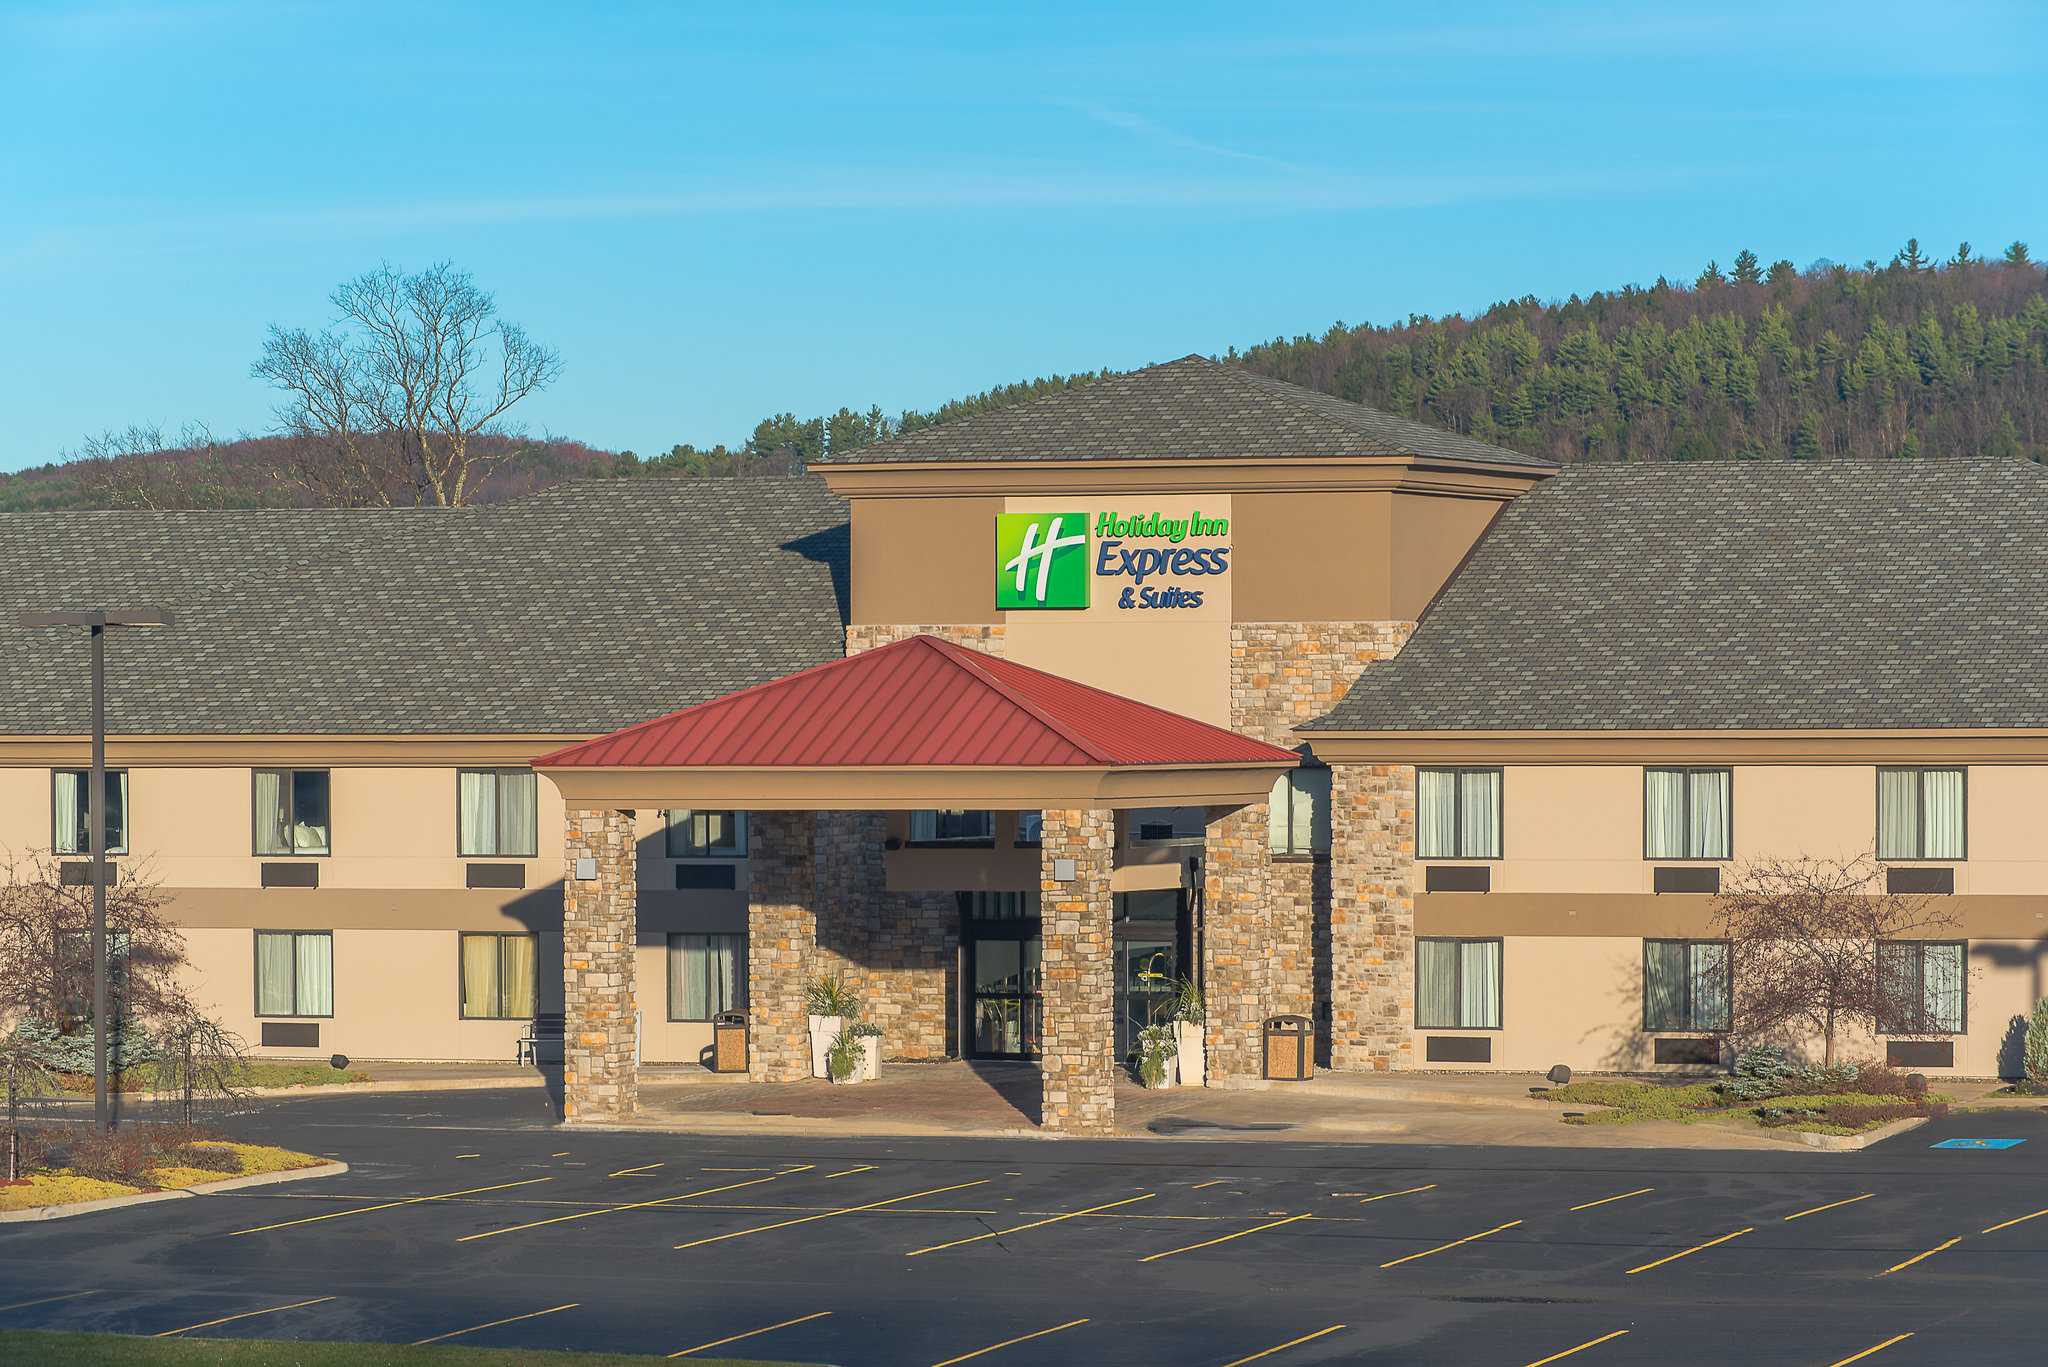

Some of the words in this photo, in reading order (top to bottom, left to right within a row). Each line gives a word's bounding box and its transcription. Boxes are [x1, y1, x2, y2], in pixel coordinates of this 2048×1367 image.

[1096, 511, 1187, 543] Holiday
[1191, 511, 1228, 537] Inn
[1005, 517, 1086, 602] H
[1096, 540, 1230, 585] Express
[1118, 586, 1136, 609] &
[1138, 586, 1204, 609] Suites
